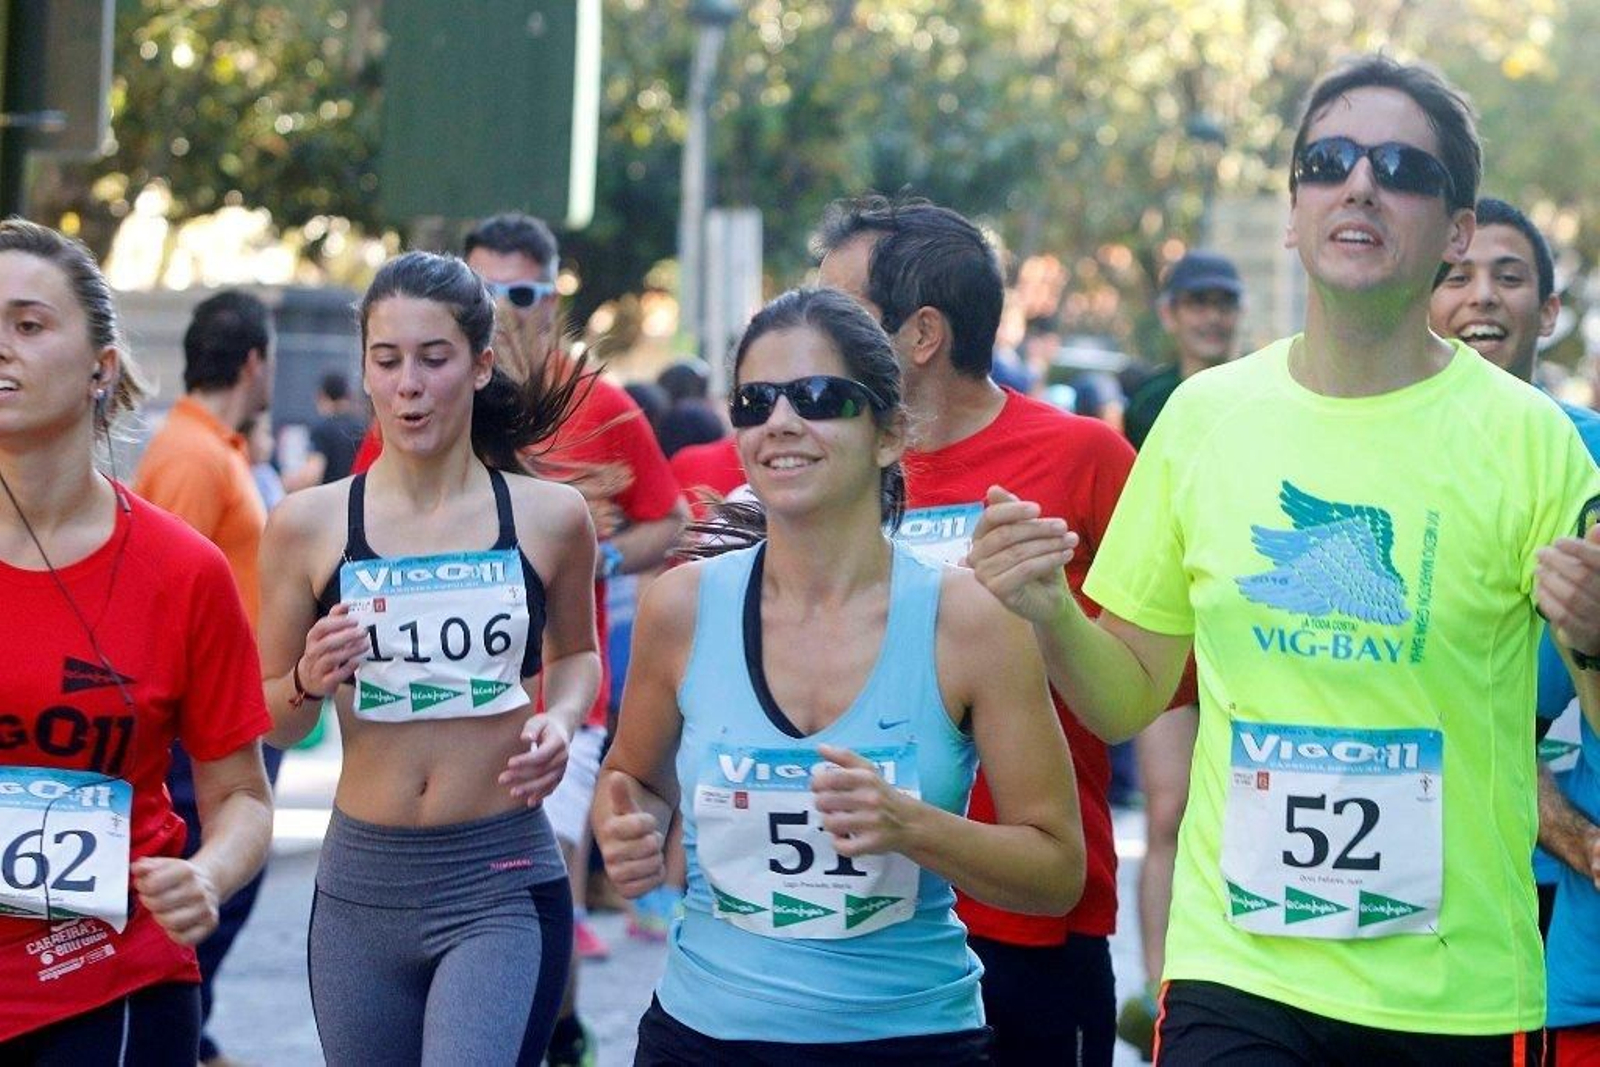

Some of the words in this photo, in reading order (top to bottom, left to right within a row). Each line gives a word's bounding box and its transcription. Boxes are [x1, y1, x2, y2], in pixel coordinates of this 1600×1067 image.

[366, 613, 512, 663] 1106
[1252, 625, 1404, 664] VIG-BAY
[1283, 794, 1381, 871] 52
[2, 829, 97, 892] 62
[26, 922, 89, 955] CARREIRA
